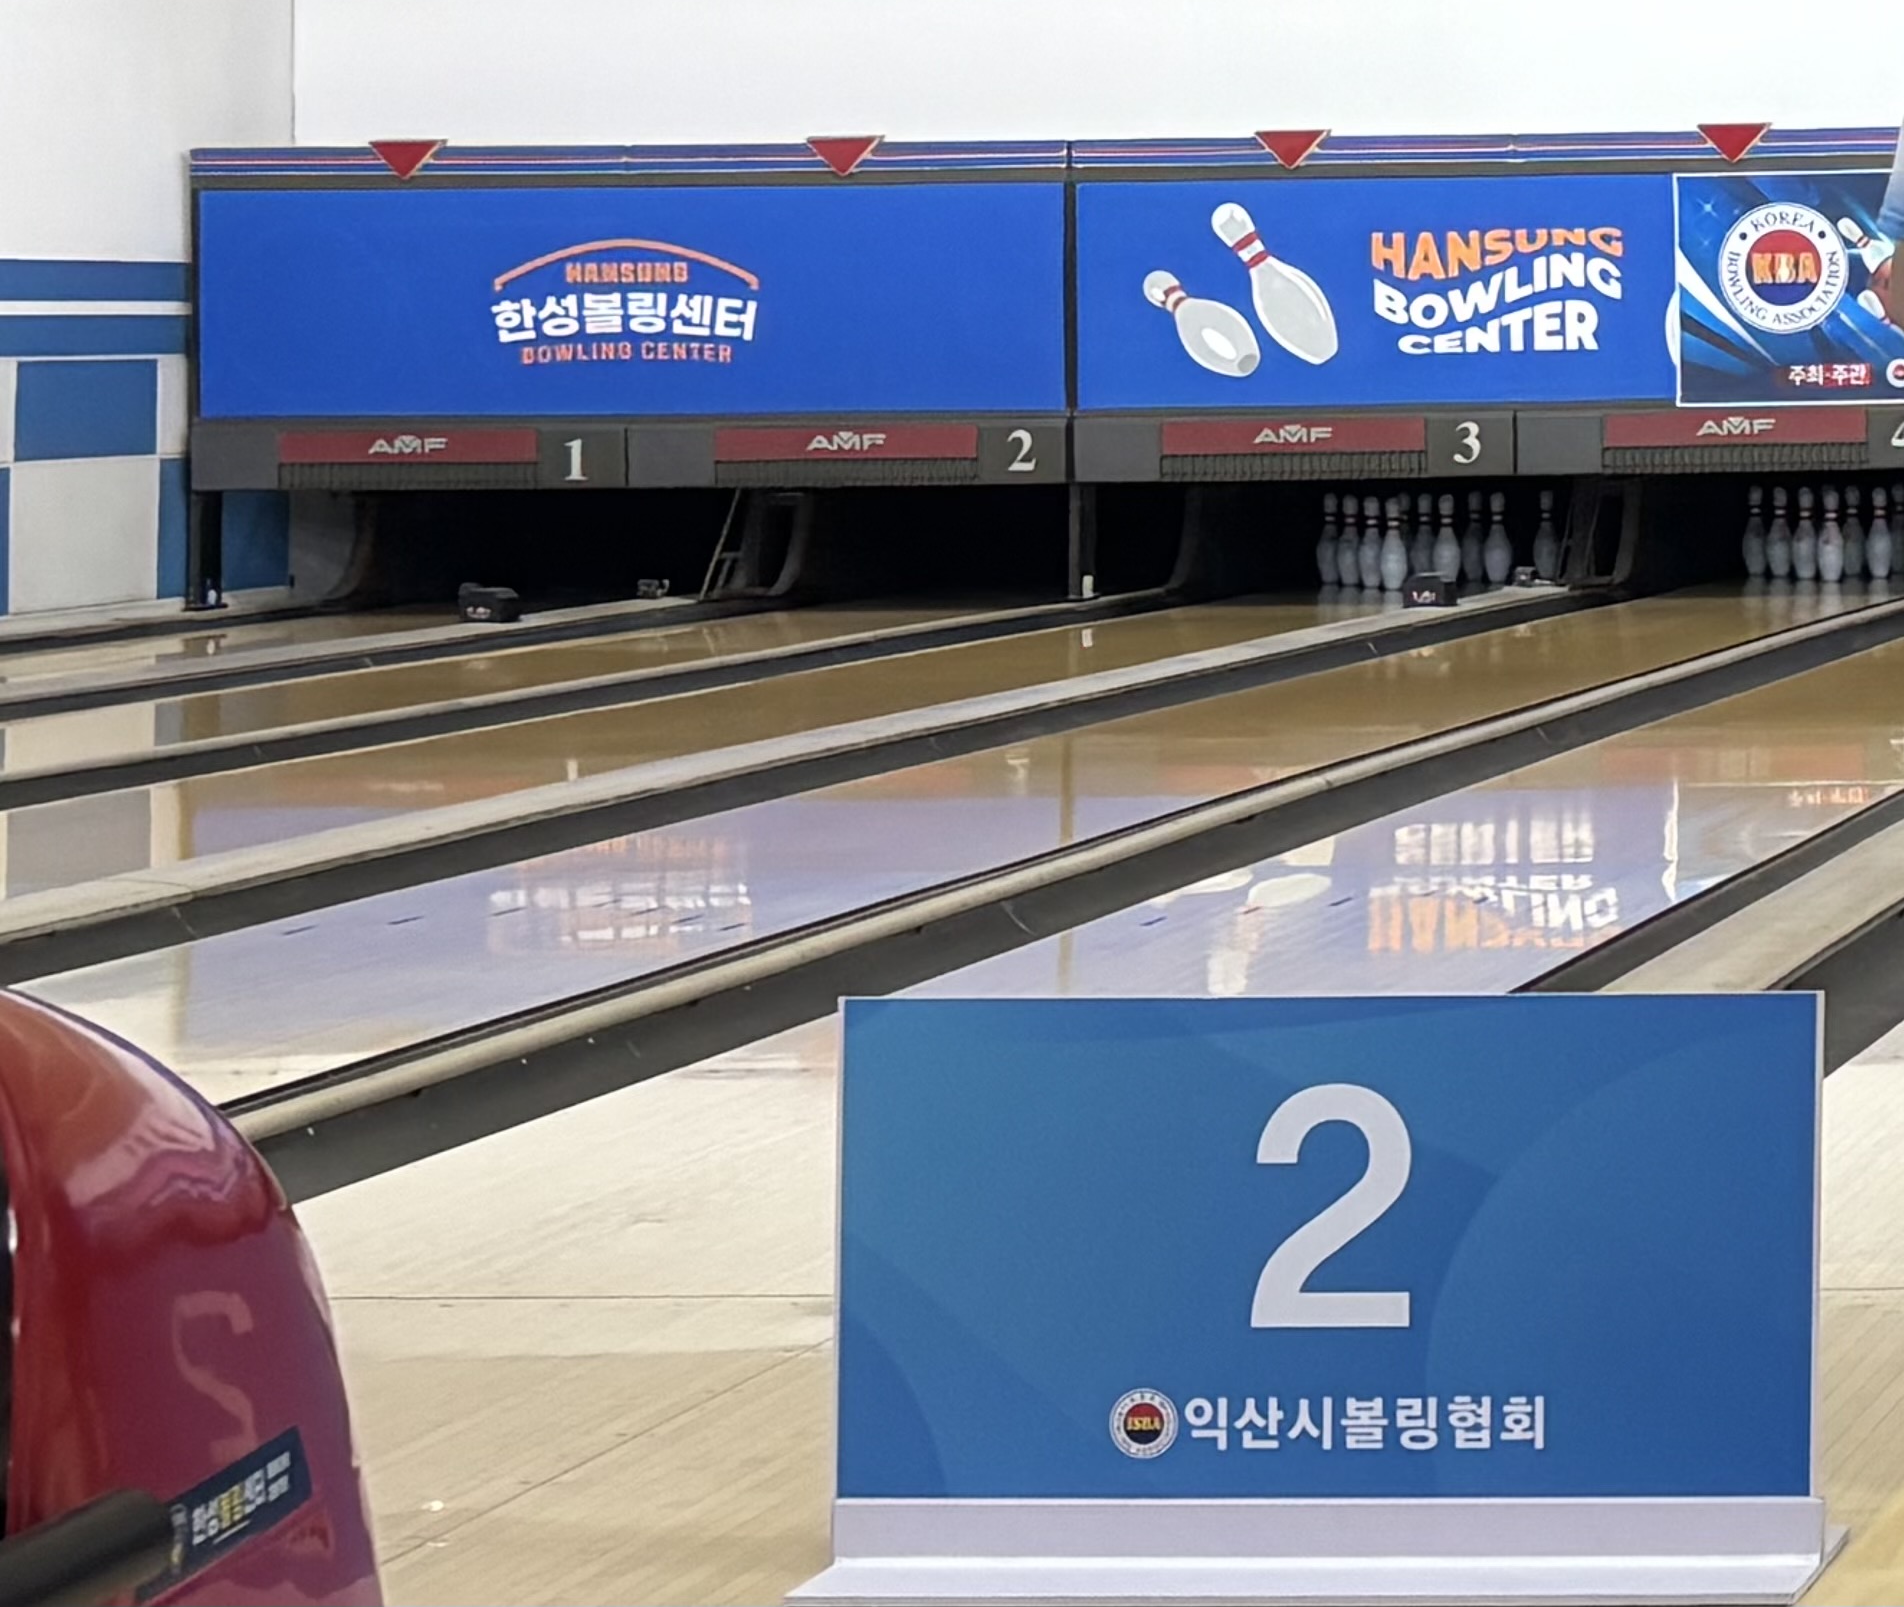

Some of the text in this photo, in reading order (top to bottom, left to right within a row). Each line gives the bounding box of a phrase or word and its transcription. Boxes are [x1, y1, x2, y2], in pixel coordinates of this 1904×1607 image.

[1750, 210, 1816, 234] KOREA
[565, 262, 689, 283] HANSUNG
[1370, 227, 1624, 281] HANSUNG
[1751, 251, 1818, 285] KBA
[1373, 252, 1623, 328] BOWLING
[490, 292, 758, 344] 한성볼링센터
[1397, 299, 1600, 355] CENTER
[521, 341, 732, 365] BOWLING CENTER
[368, 435, 448, 454] AMF
[806, 431, 887, 451] AMF
[1253, 424, 1333, 444] AMF
[1453, 421, 1481, 464] 3
[1696, 416, 1776, 436] AMF
[565, 438, 587, 480] 1
[1007, 429, 1036, 471] 2
[1250, 1082, 1412, 1329] 2
[1183, 1395, 1546, 1451] 익산시볼링협회
